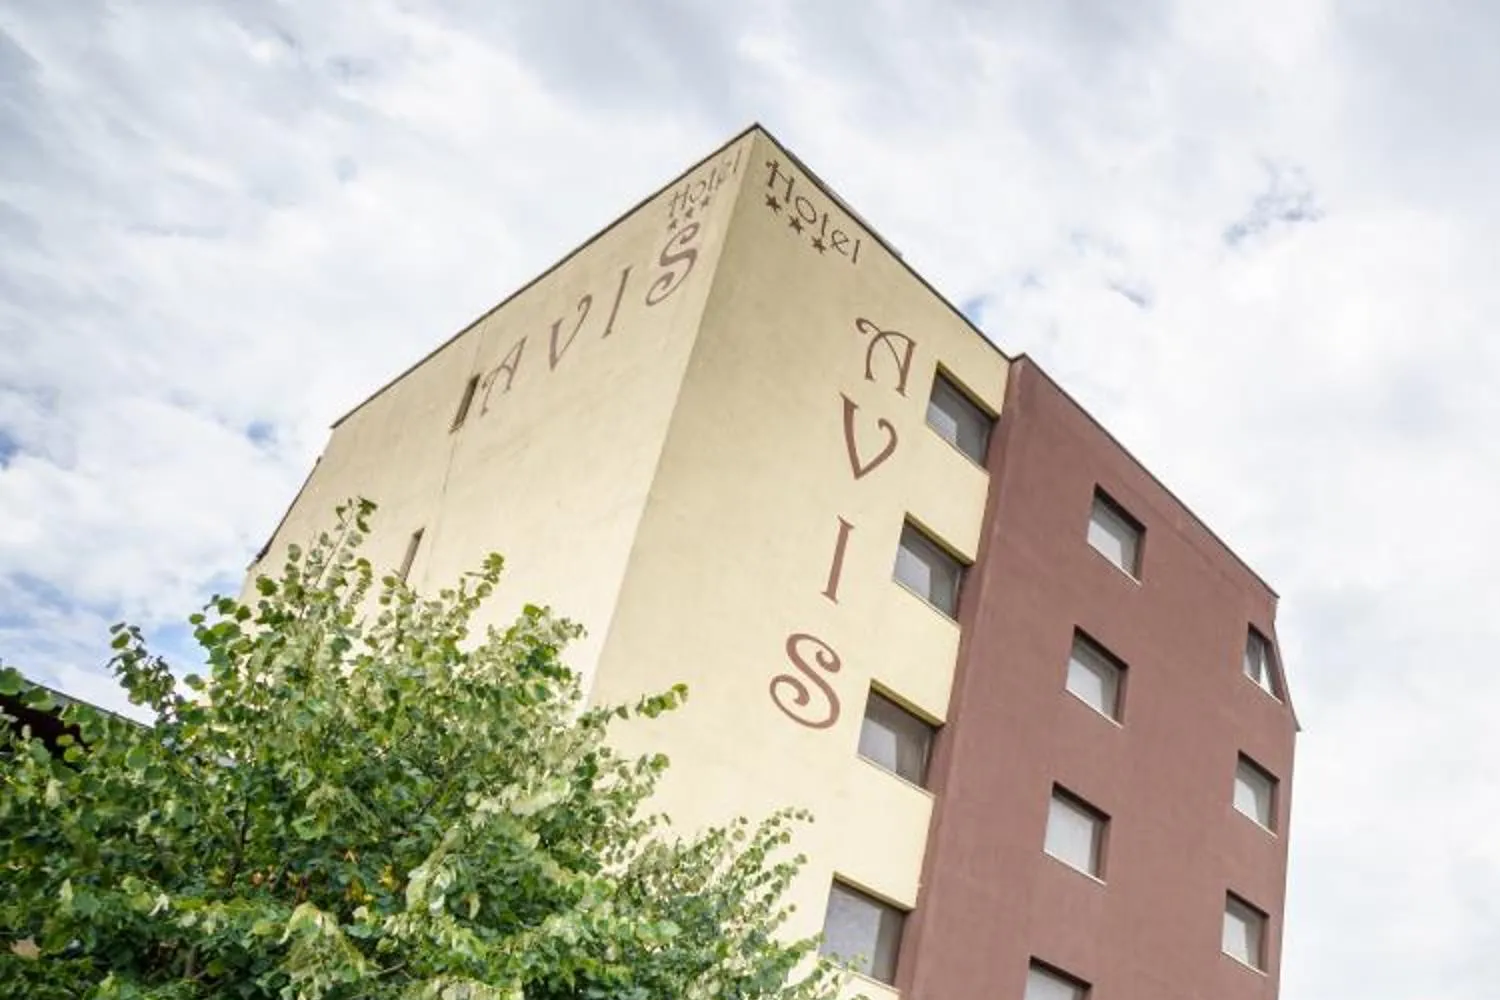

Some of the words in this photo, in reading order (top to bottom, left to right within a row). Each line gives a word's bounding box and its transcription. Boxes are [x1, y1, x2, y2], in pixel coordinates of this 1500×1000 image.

[765, 160, 861, 265] Hotel
[479, 221, 701, 418] AVIS
[769, 316, 917, 730] AVIS
